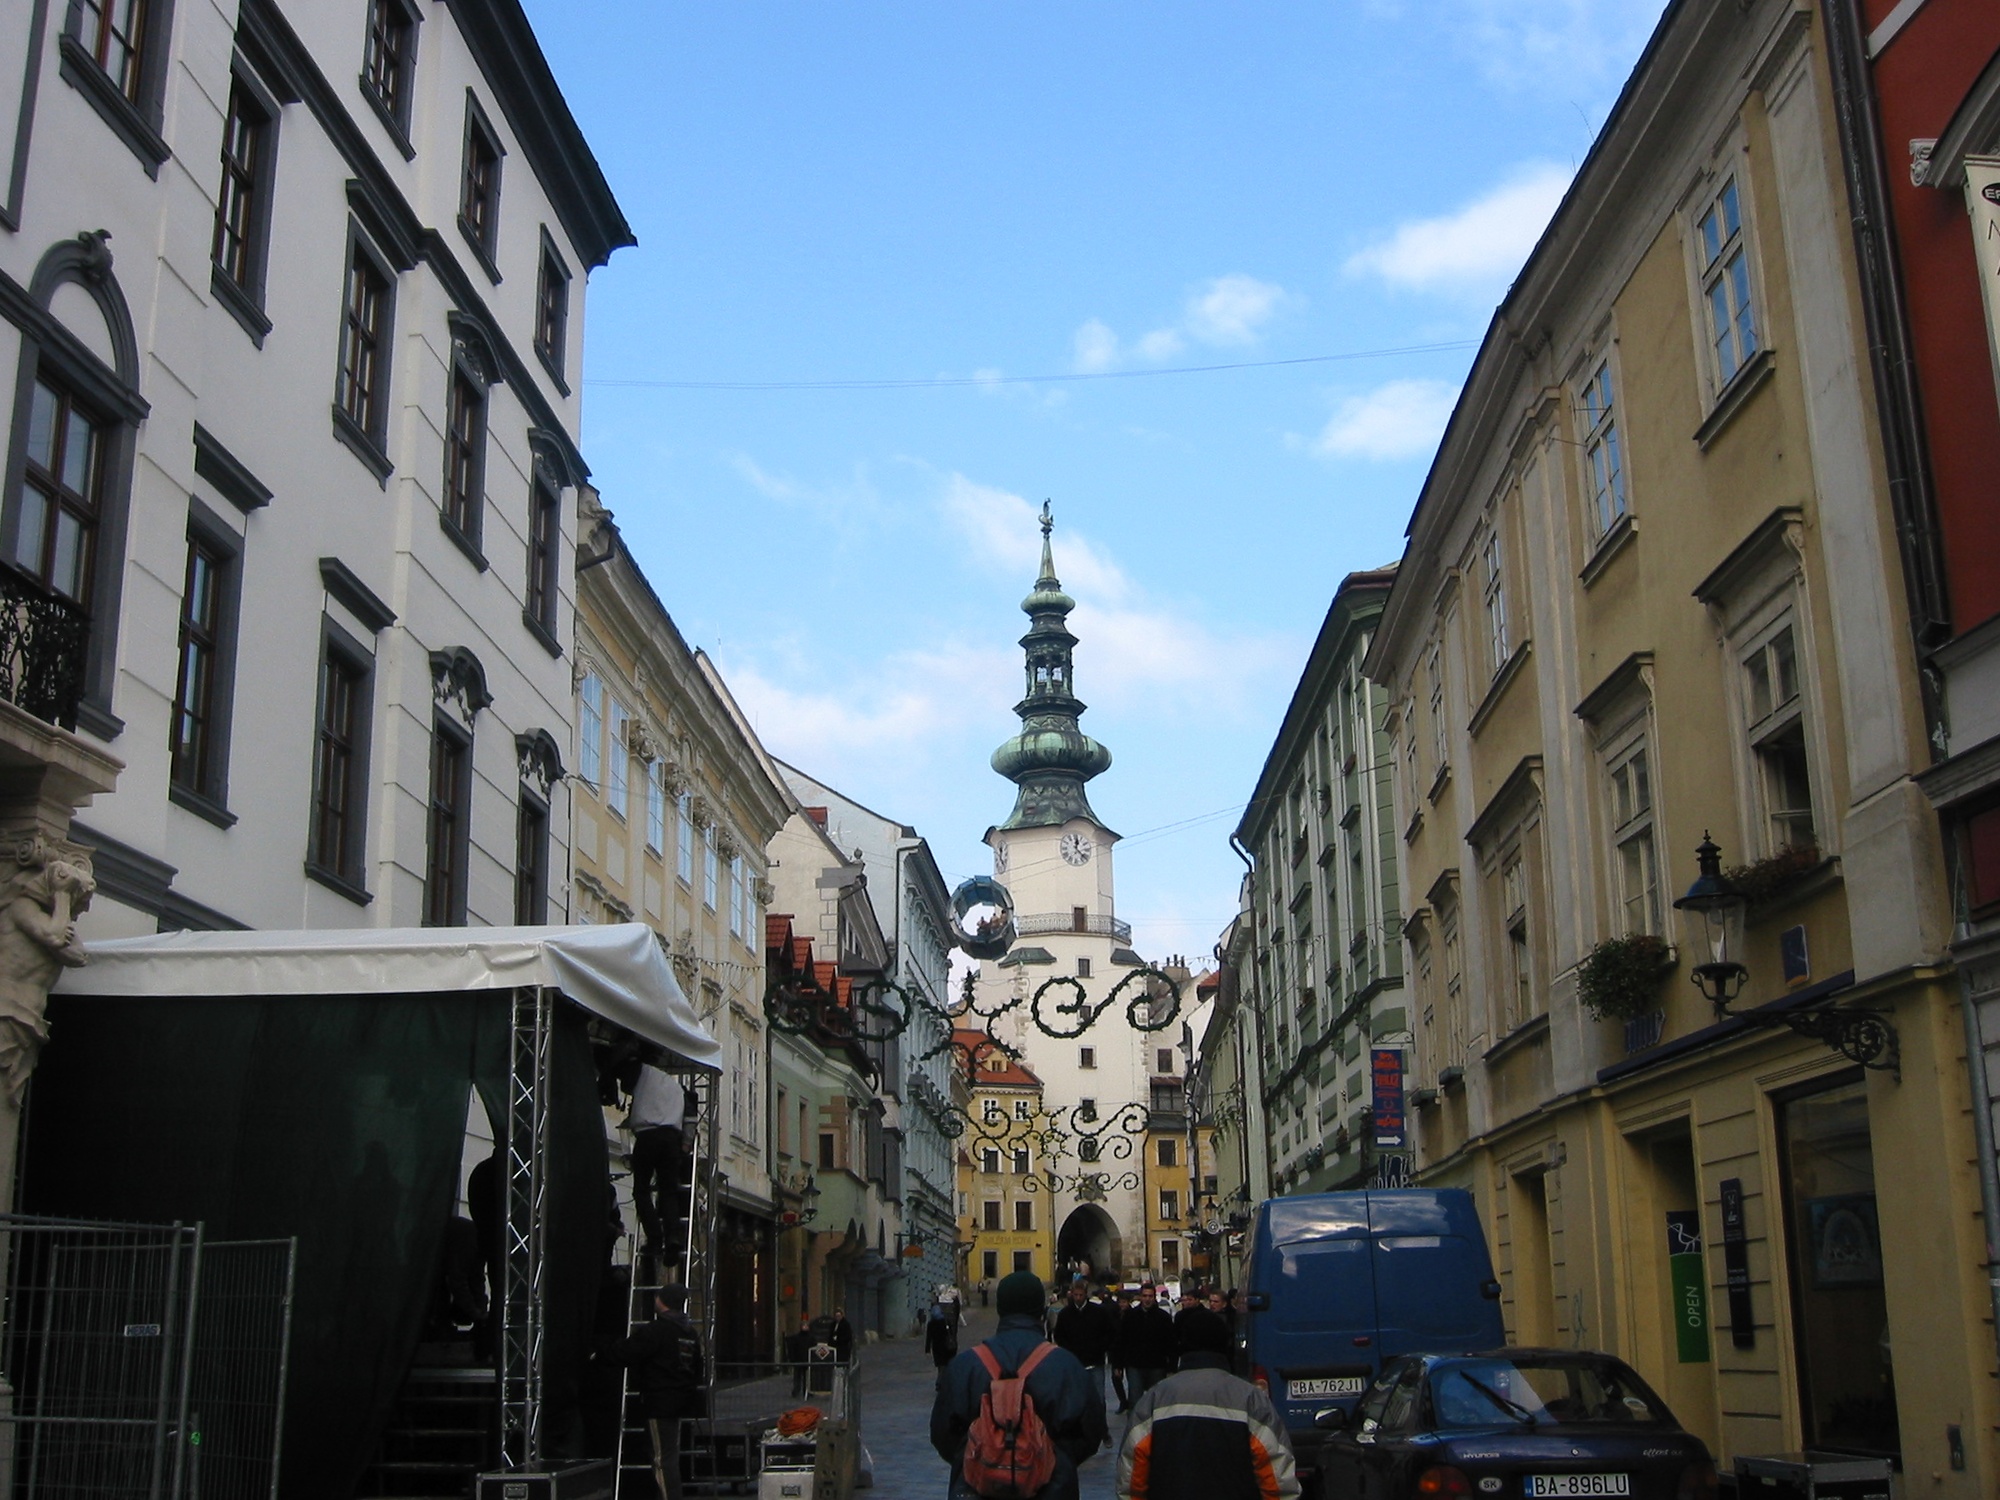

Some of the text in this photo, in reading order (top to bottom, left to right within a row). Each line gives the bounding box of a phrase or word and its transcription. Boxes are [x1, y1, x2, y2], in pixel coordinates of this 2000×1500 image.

[1686, 1285, 1702, 1328] OPEN
[1300, 1379, 1359, 1394] BA-762JI
[1483, 1480, 1497, 1489] SK
[1534, 1475, 1628, 1495] BA-896LU
